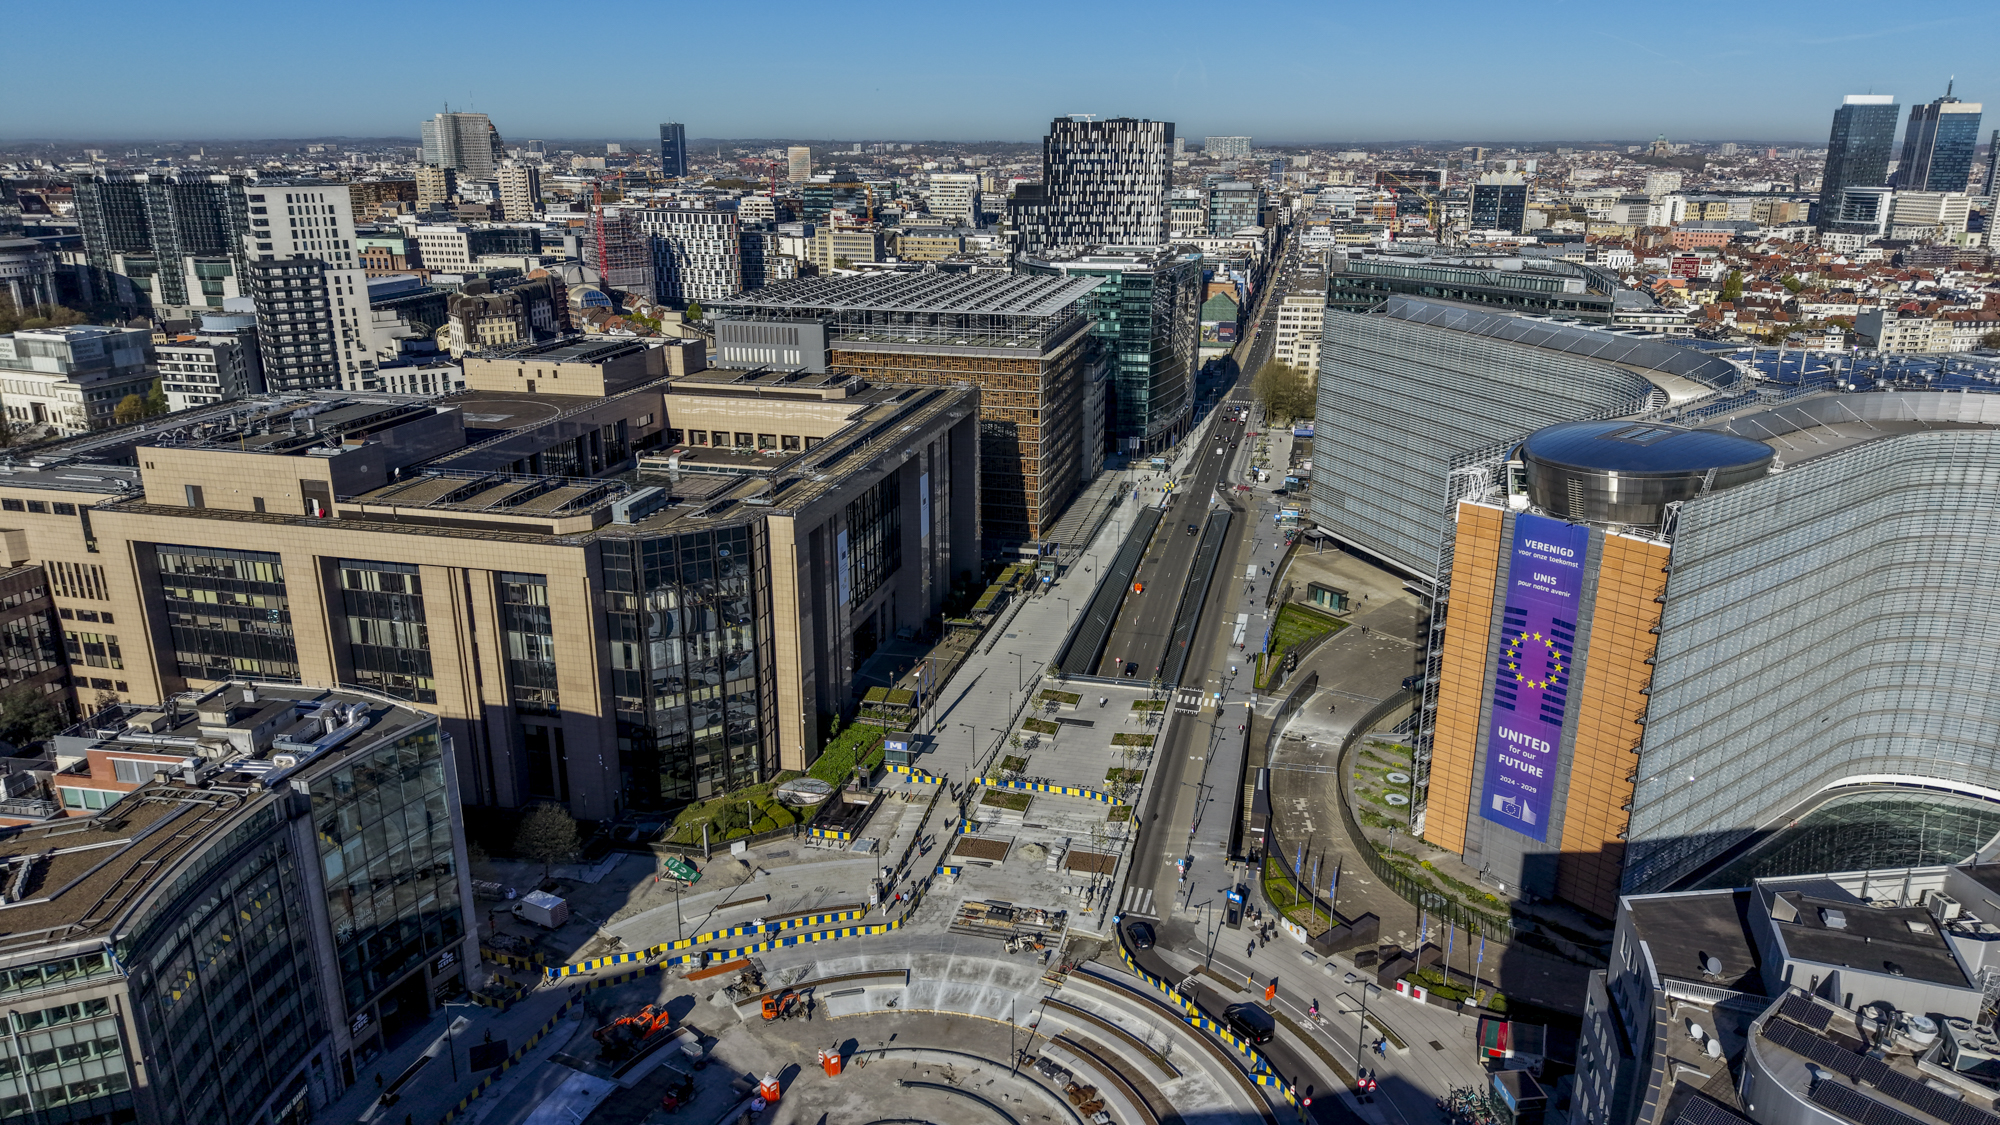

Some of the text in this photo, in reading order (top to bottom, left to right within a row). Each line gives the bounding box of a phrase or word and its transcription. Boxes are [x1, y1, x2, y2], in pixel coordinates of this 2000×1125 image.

[1525, 539, 1574, 557] VERENIGD
[1550, 556, 1578, 568] toekomst
[1534, 572, 1557, 585] UNIS
[1532, 584, 1550, 592] notre
[1550, 588, 1571, 598] avenir
[1498, 726, 1550, 754] UNITED
[1509, 744, 1536, 760] for our
[1498, 754, 1544, 778] FUTURE
[1500, 775, 1516, 786] 2024
[1521, 783, 1537, 794] 2029
